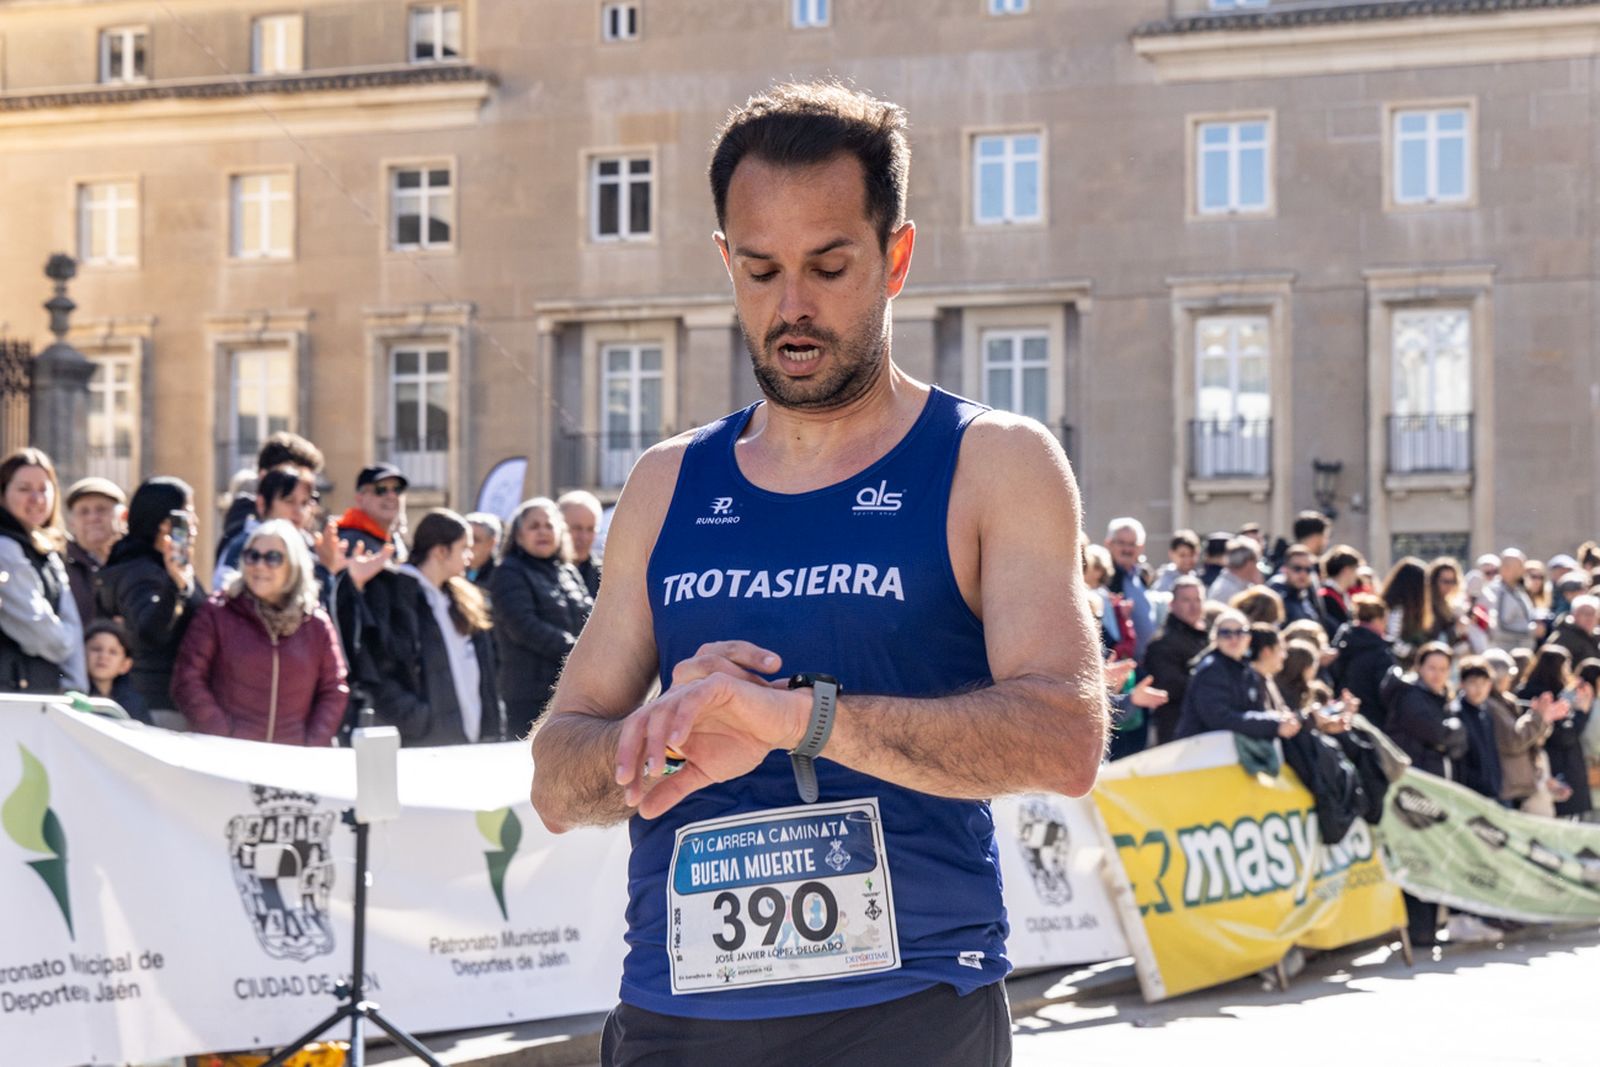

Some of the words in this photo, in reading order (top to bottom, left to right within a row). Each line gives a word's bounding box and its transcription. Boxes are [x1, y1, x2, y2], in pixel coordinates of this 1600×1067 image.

[695, 516, 741, 525] RUNOPRO
[663, 563, 905, 606] TROTASIERRA
[691, 840, 704, 854] VI
[706, 829, 766, 851] CARRERA
[768, 820, 849, 844] CAMINATA
[691, 861, 740, 887] BUENA
[744, 848, 816, 880] MUERTE
[712, 881, 839, 951] 390
[429, 935, 498, 954] Patronato
[501, 928, 560, 949] Municipal
[563, 926, 580, 942] de
[737, 950, 766, 962] JAVIER
[796, 941, 843, 955] DELGADO
[138, 949, 164, 971] de
[451, 956, 514, 977] Deportes
[516, 954, 533, 969] de
[538, 950, 571, 968] Jaén
[94, 979, 141, 1003] Jaén
[234, 974, 304, 1000] CIUDAD
[307, 974, 332, 995] DE
